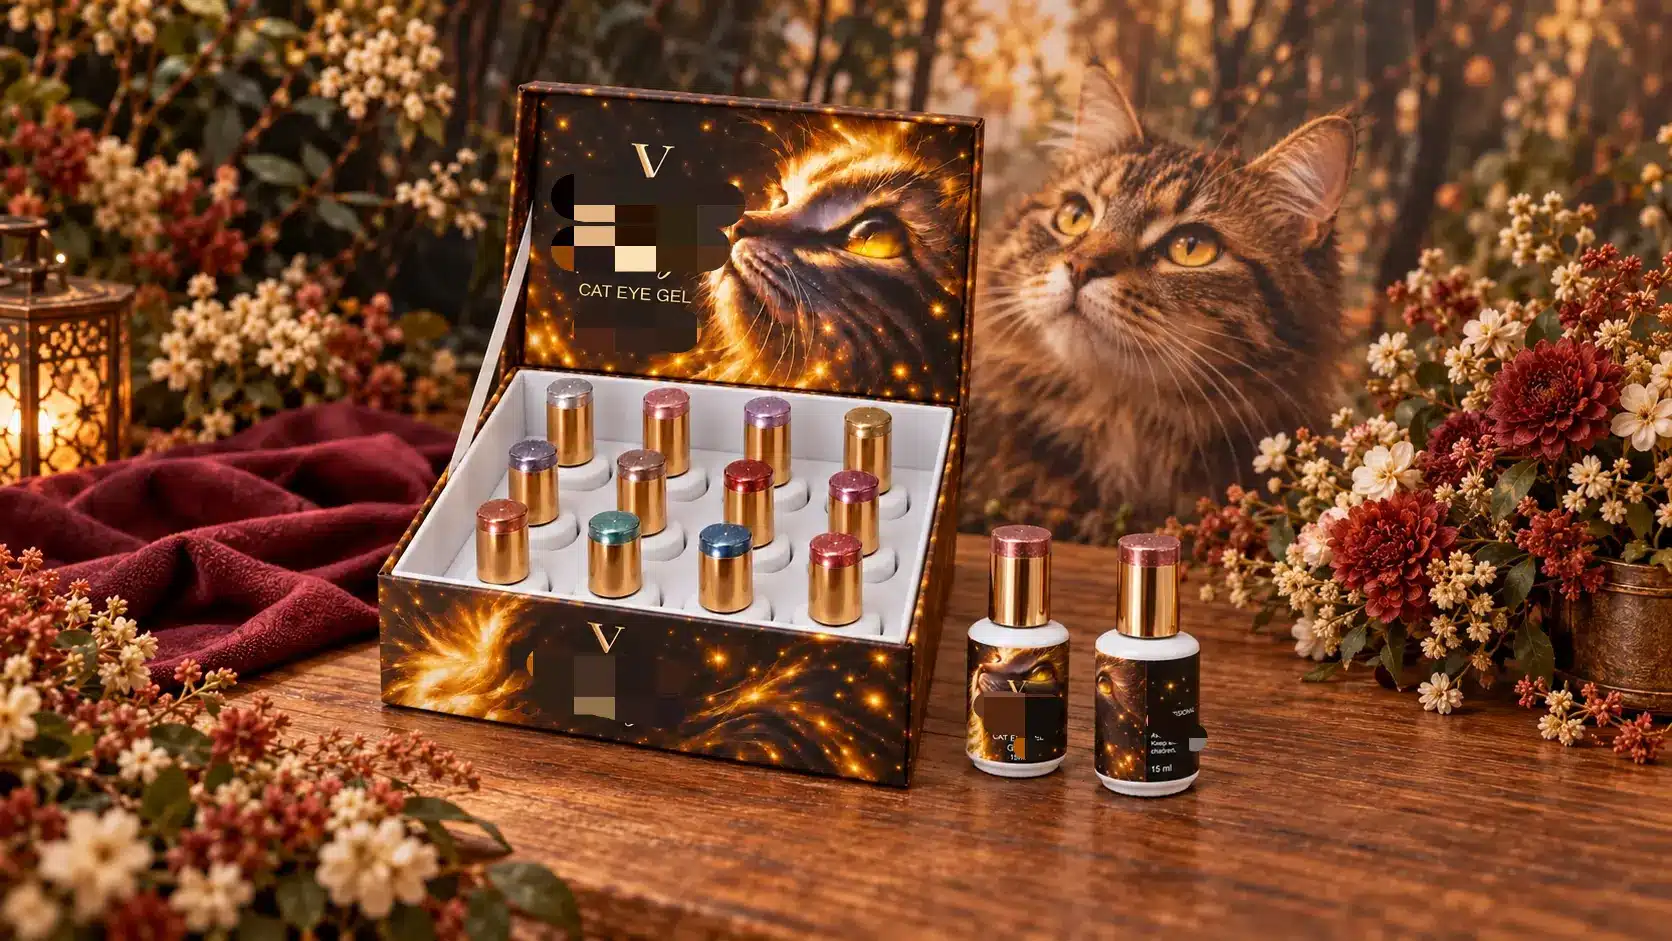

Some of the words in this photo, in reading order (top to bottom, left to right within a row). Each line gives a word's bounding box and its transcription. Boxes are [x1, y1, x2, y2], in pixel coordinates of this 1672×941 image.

[631, 143, 675, 179] V
[578, 283, 612, 298] CAT
[616, 286, 651, 301] EYE
[656, 289, 692, 304] GEL
[587, 621, 626, 654] V
[1151, 765, 1161, 773] 15
[1162, 764, 1173, 773] ml
